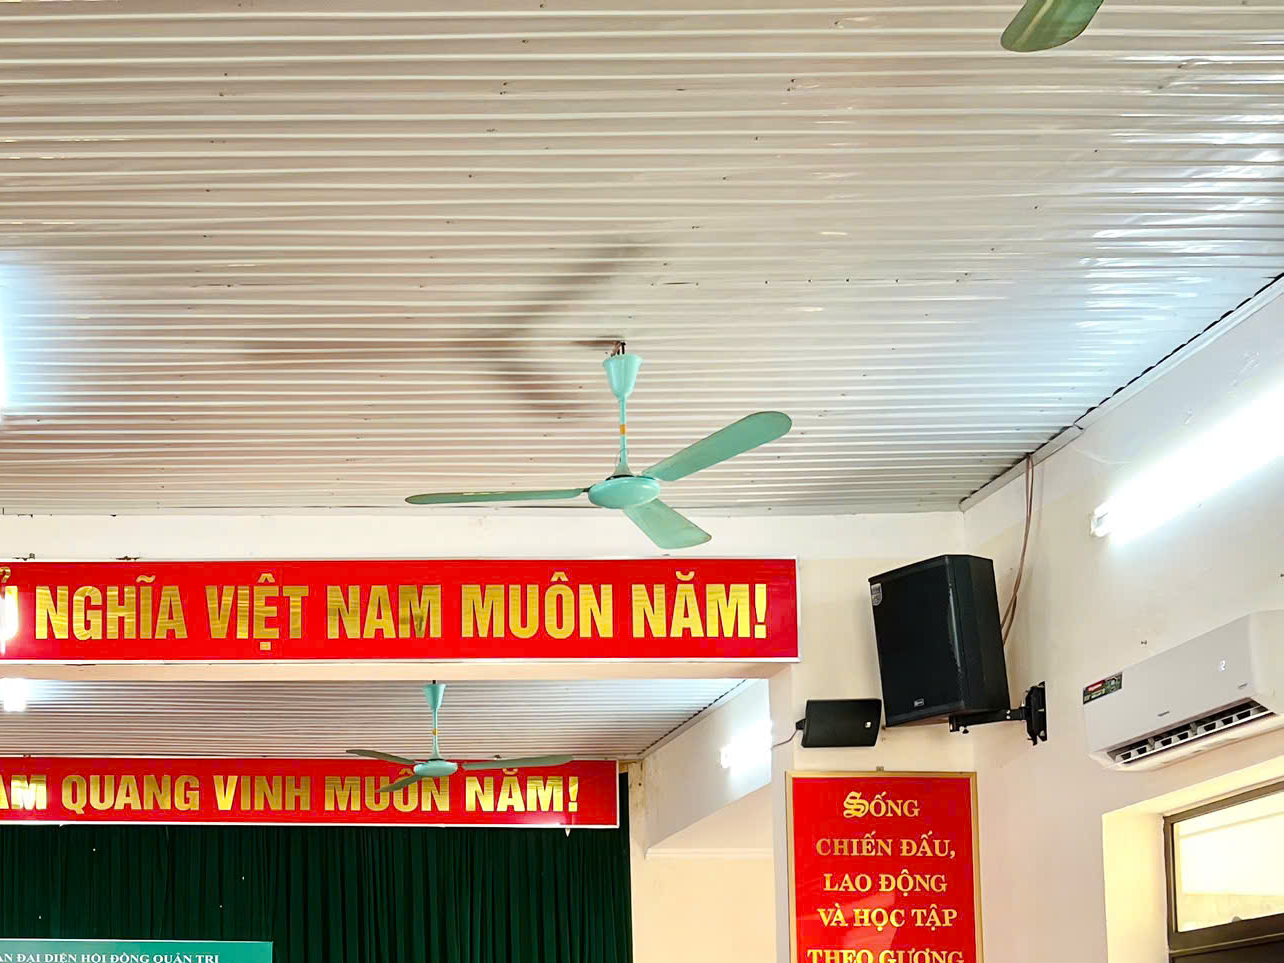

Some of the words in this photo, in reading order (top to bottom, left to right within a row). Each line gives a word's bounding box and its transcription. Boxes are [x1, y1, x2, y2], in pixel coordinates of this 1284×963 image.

[35, 574, 188, 641] NGHĨA
[205, 573, 309, 651] VIỆT
[327, 584, 442, 640] NAM
[461, 571, 614, 640] MUÔN
[631, 570, 768, 639] NĂM!
[61, 774, 200, 815] QUANG
[213, 774, 311, 811] VINH
[324, 767, 450, 812] MUÔN
[466, 767, 579, 813] NĂM!
[843, 791, 920, 818] SỐNG
[815, 830, 893, 857] CHIẾN
[900, 830, 956, 859] ĐẤU,
[823, 873, 872, 892] LAO
[878, 868, 948, 896] ĐỘNG
[817, 902, 848, 927] VÀ
[852, 908, 905, 931] HỌC
[911, 903, 958, 931] TẬP
[16, 953, 40, 963] ĐẠI
